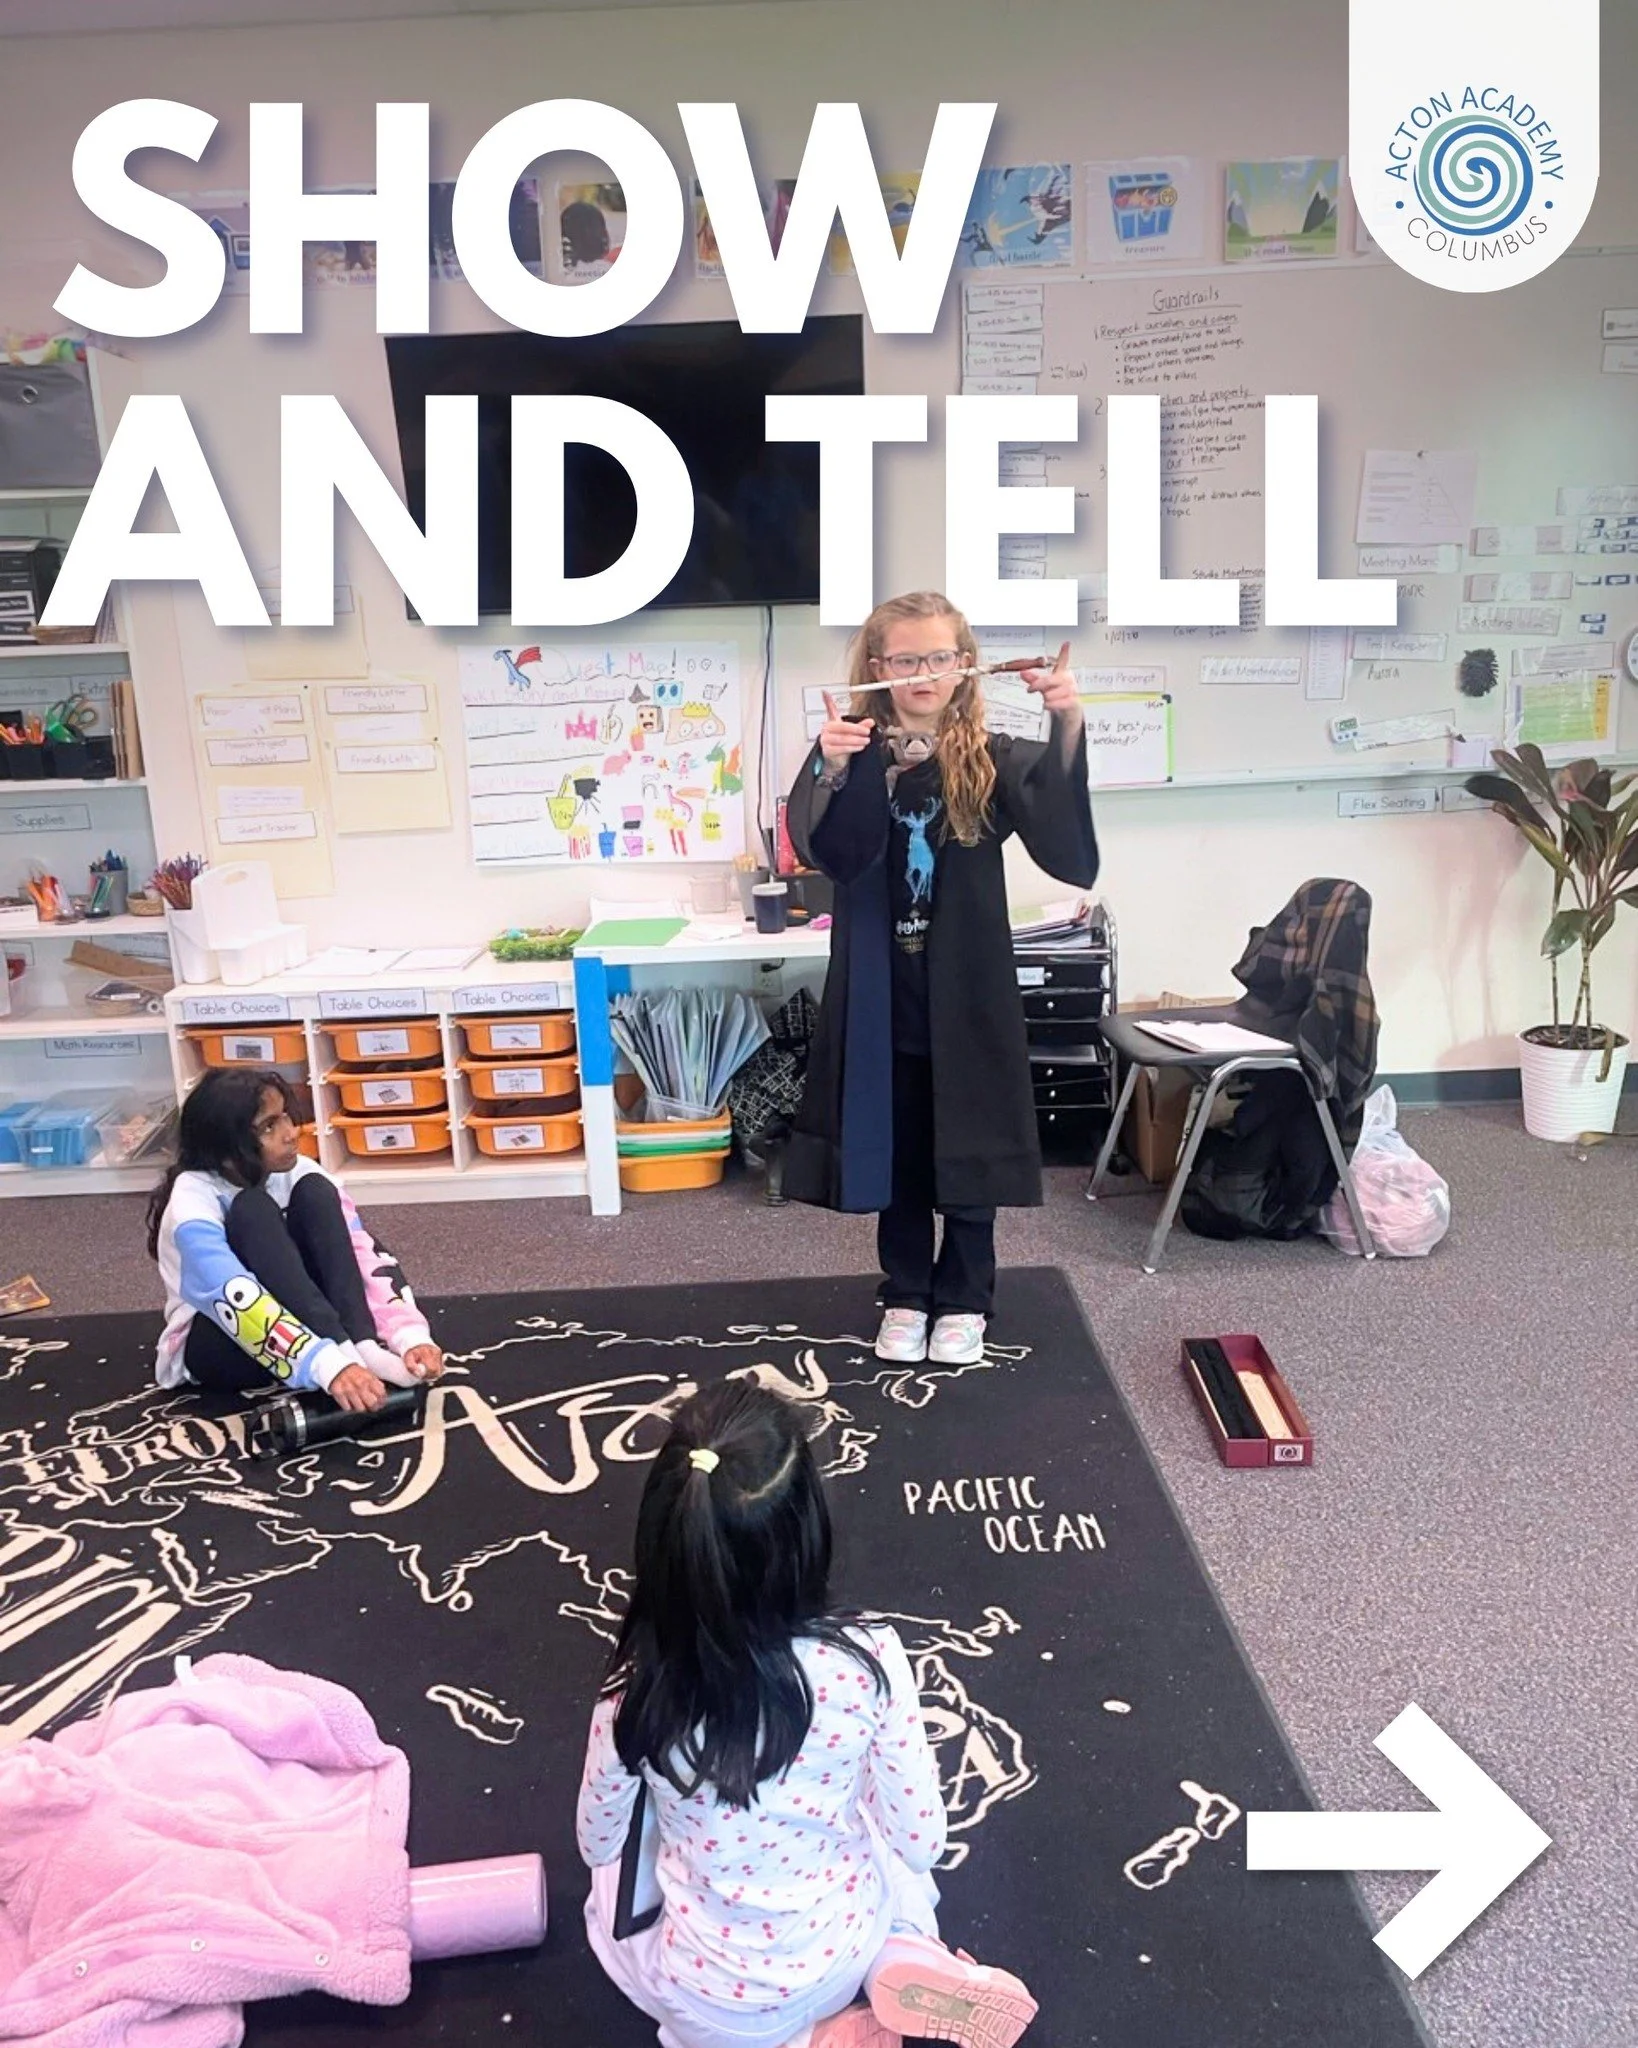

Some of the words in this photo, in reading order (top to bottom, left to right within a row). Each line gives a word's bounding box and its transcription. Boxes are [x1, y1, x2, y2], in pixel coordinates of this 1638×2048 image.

[1125, 244, 1165, 255] treasure
[1263, 245, 1286, 256] road
[1153, 286, 1219, 312] Guardrails
[1100, 322, 1139, 338] Respect
[1361, 555, 1406, 570] Meeting
[1116, 672, 1157, 685] Prompt
[1352, 798, 1377, 810] Flex
[1380, 795, 1427, 811] Seating
[14, 812, 66, 828] Supplies
[328, 997, 363, 1011] Table
[367, 997, 418, 1011] Choices
[464, 992, 498, 1006] Table
[501, 990, 551, 1005] Choices
[193, 1001, 228, 1015] Table
[231, 1001, 281, 1015] Choices
[53, 1040, 82, 1051] Math
[903, 1476, 1045, 1515] PACIFIC
[984, 1513, 1107, 1554] OCEAN
